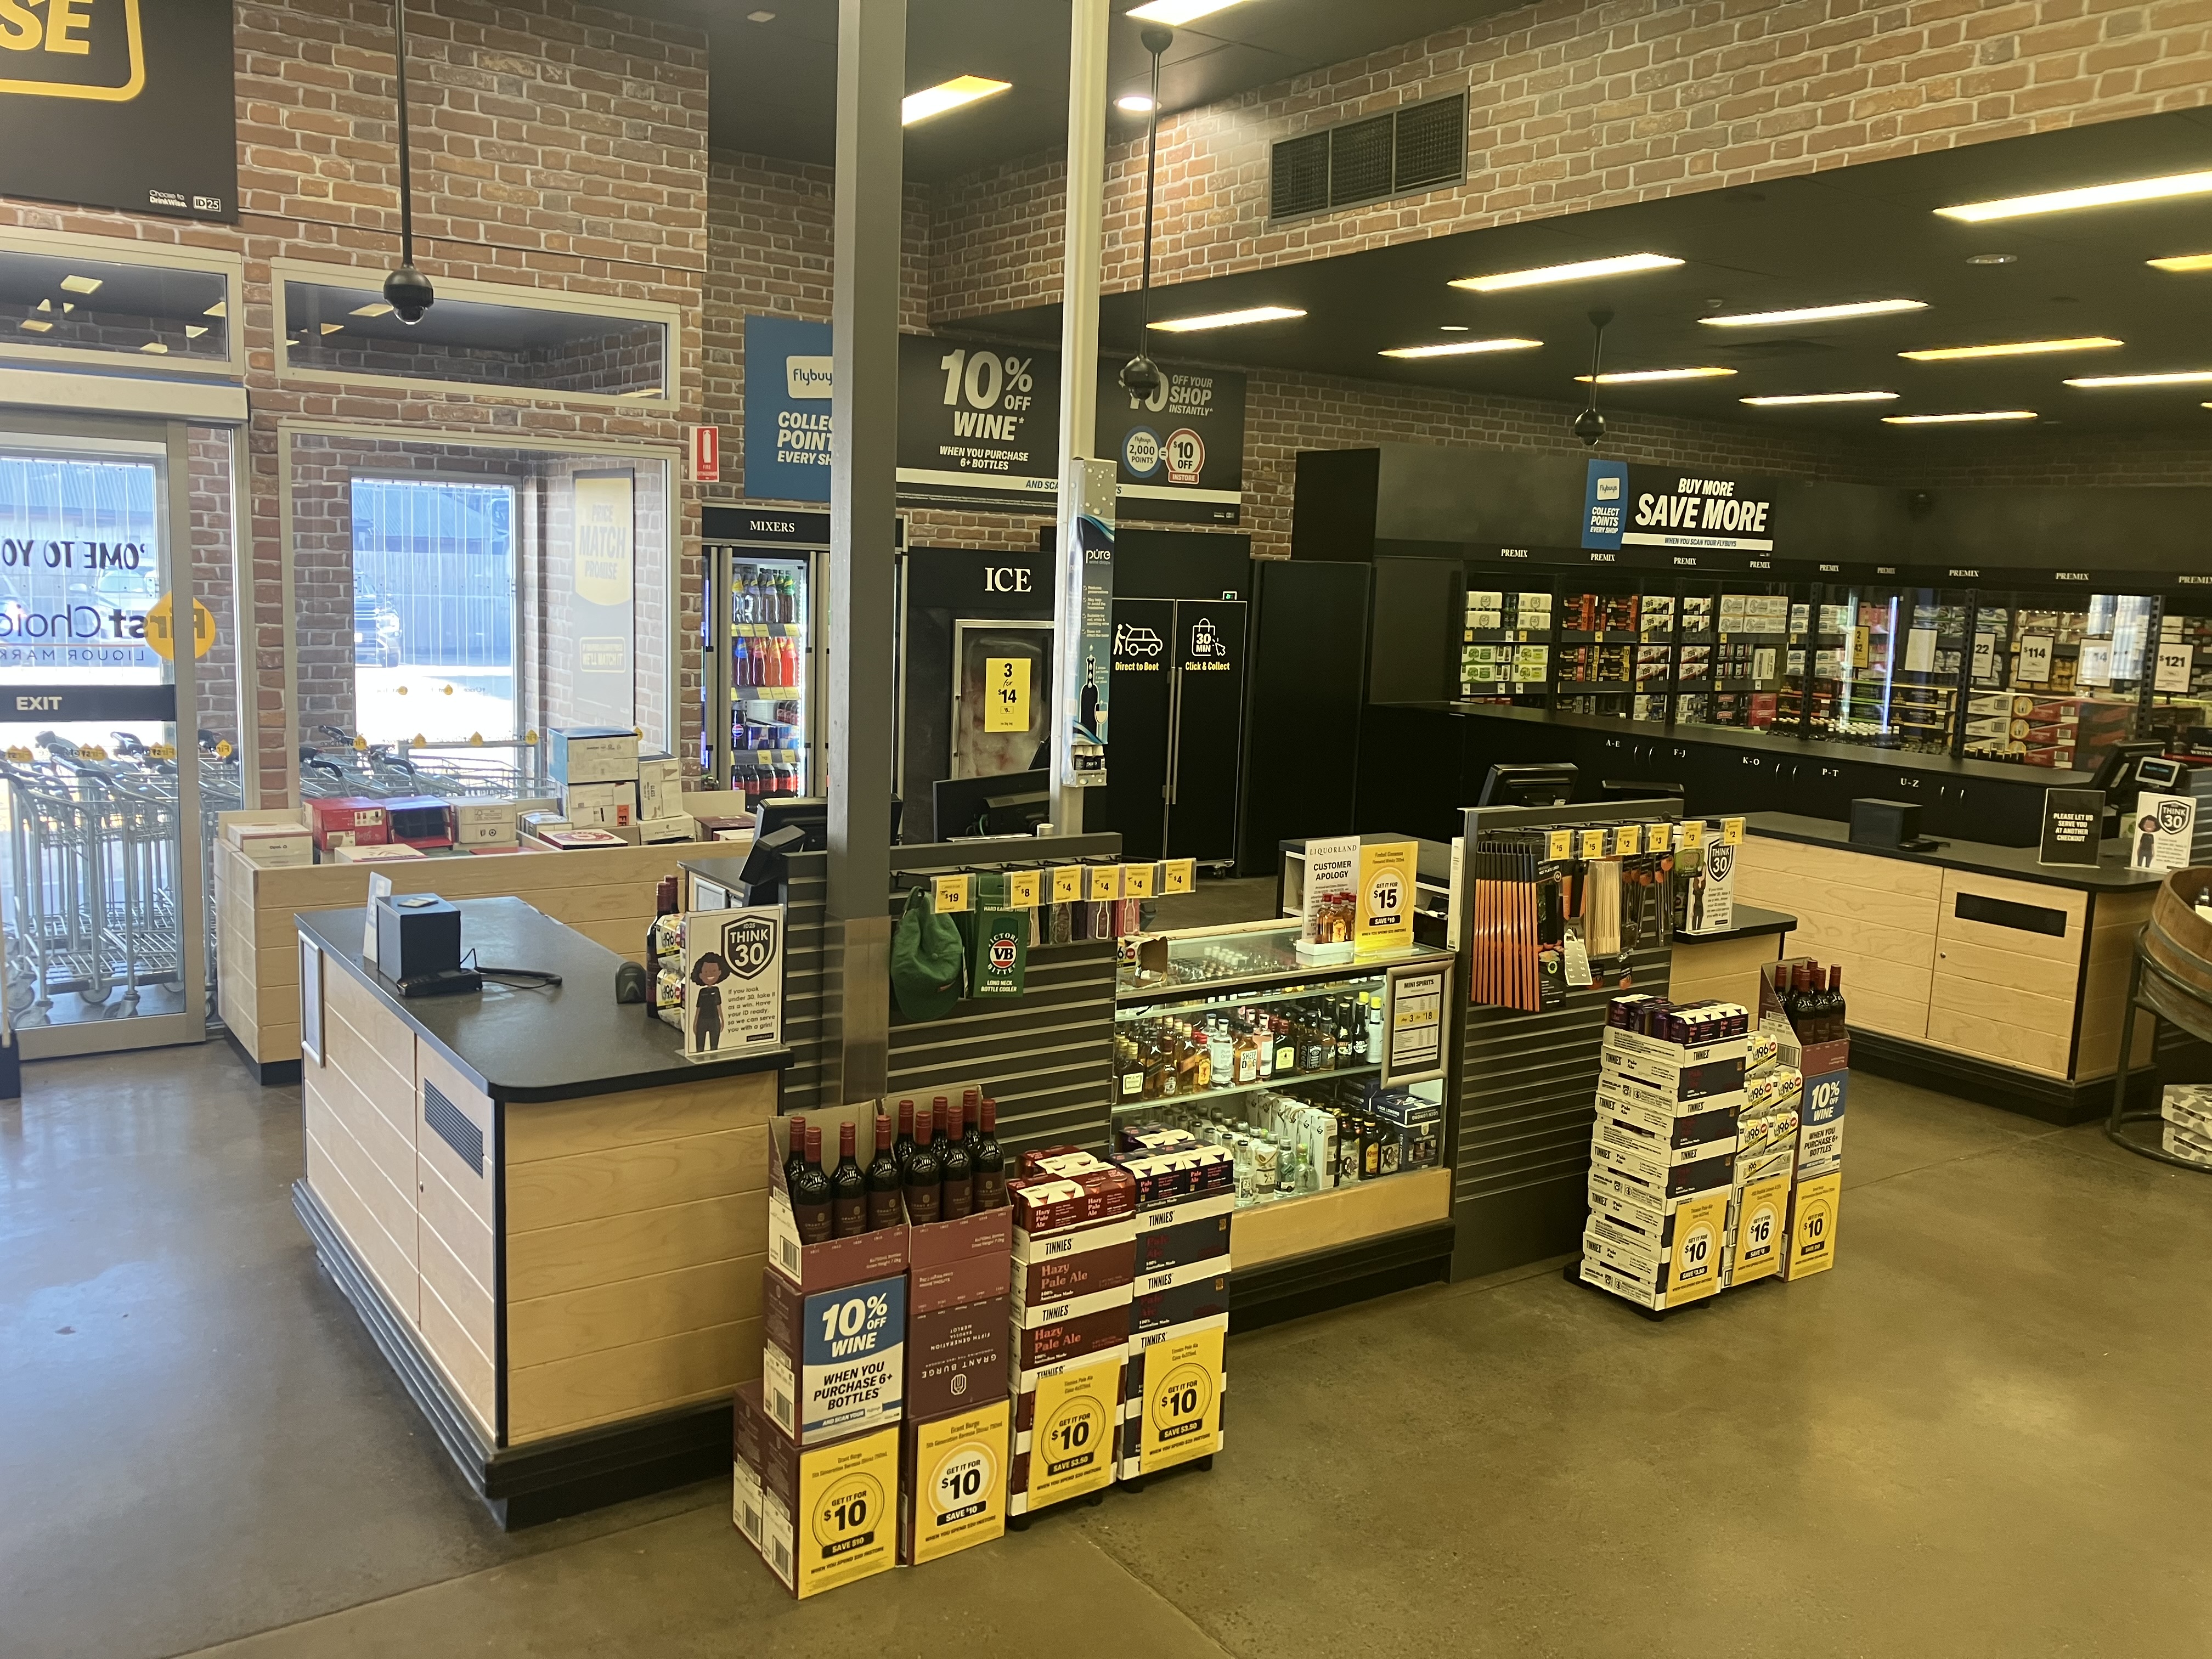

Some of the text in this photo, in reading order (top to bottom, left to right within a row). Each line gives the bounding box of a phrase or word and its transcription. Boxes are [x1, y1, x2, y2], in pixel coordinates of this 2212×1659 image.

[941, 349, 1032, 410] 10%
[1172, 374, 1212, 388] OFF YOUR
[1004, 394, 1031, 411] OFF
[1169, 386, 1212, 405] SHOP
[940, 445, 1029, 461] WHEN YOU PURCHASE
[1129, 444, 1155, 456] 2,000
[1173, 441, 1194, 459] $10
[777, 450, 816, 465] EVERY
[960, 458, 1009, 470] 6+ BOTTLES
[1178, 460, 1193, 469] OFF
[1678, 478, 1735, 496] BUY MORE
[591, 504, 614, 523] PRICE
[1592, 506, 1620, 517] COLLECT
[1635, 493, 1769, 532] SAVE MORE
[750, 520, 795, 533] MIXERS
[1591, 515, 1619, 527] POINTS
[579, 525, 627, 559] MATCH
[1501, 549, 1528, 558] PREMIX
[1591, 553, 1615, 562] PREMIX
[584, 560, 618, 580] PROMISE
[985, 567, 1032, 592] ICE
[1196, 633, 1211, 645] 30
[1195, 644, 1211, 652] MIN
[2023, 646, 2045, 658] $114
[1115, 662, 1159, 671] Direct to Boot
[1185, 662, 1230, 671] Click & Collect
[2159, 654, 2186, 668] $121
[1003, 663, 1013, 678] 3
[1002, 679, 1013, 688] for
[16, 696, 63, 710] EXIT
[998, 689, 1017, 703] $14
[2053, 812, 2075, 821] PLEASE
[2163, 805, 2186, 816] THINK
[2058, 820, 2076, 828] SERVE
[2164, 815, 2182, 829] 30
[1310, 844, 1357, 856] LIQUORLAND
[1313, 860, 1352, 871] CUSTOMER
[1315, 870, 1349, 881] APOLOGY
[1021, 888, 1030, 898] $8
[1062, 882, 1071, 892] $4
[1101, 882, 1109, 891] $4
[945, 893, 960, 902] $19
[1373, 888, 1397, 909] $15
[730, 928, 769, 944] THINK
[735, 943, 764, 967] 30
[993, 947, 1013, 960] VB
[1416, 979, 1434, 987] SPIRITS
[1242, 1051, 1256, 1061] SHEEP
[1693, 1049, 1711, 1062] TINNIES
[1811, 1080, 1840, 1110] 10%
[1688, 1101, 1705, 1114] TINNIES
[1814, 1106, 1834, 1121] WINE
[1809, 1126, 1836, 1140] WHEN YOU
[1804, 1136, 1832, 1150] PURCHASE
[1810, 1144, 1832, 1157] BOTTLES
[1750, 1221, 1770, 1243] $16
[1803, 1217, 1822, 1238] $10
[1684, 1240, 1707, 1263] $10
[1750, 1250, 1760, 1258] SAVE
[1041, 1263, 1070, 1277] Hazy
[1041, 1271, 1088, 1289] Pale Ale
[1035, 1326, 1064, 1341] Hazy
[832, 1331, 878, 1358] WINE
[930, 1337, 970, 1351] GENERATION
[1034, 1333, 1081, 1353] Pale Ale
[962, 1353, 997, 1368] GRANT
[824, 1361, 885, 1386] WHEN YOU
[922, 1363, 957, 1379] BURGE
[814, 1373, 893, 1401] PURCHASE 6+
